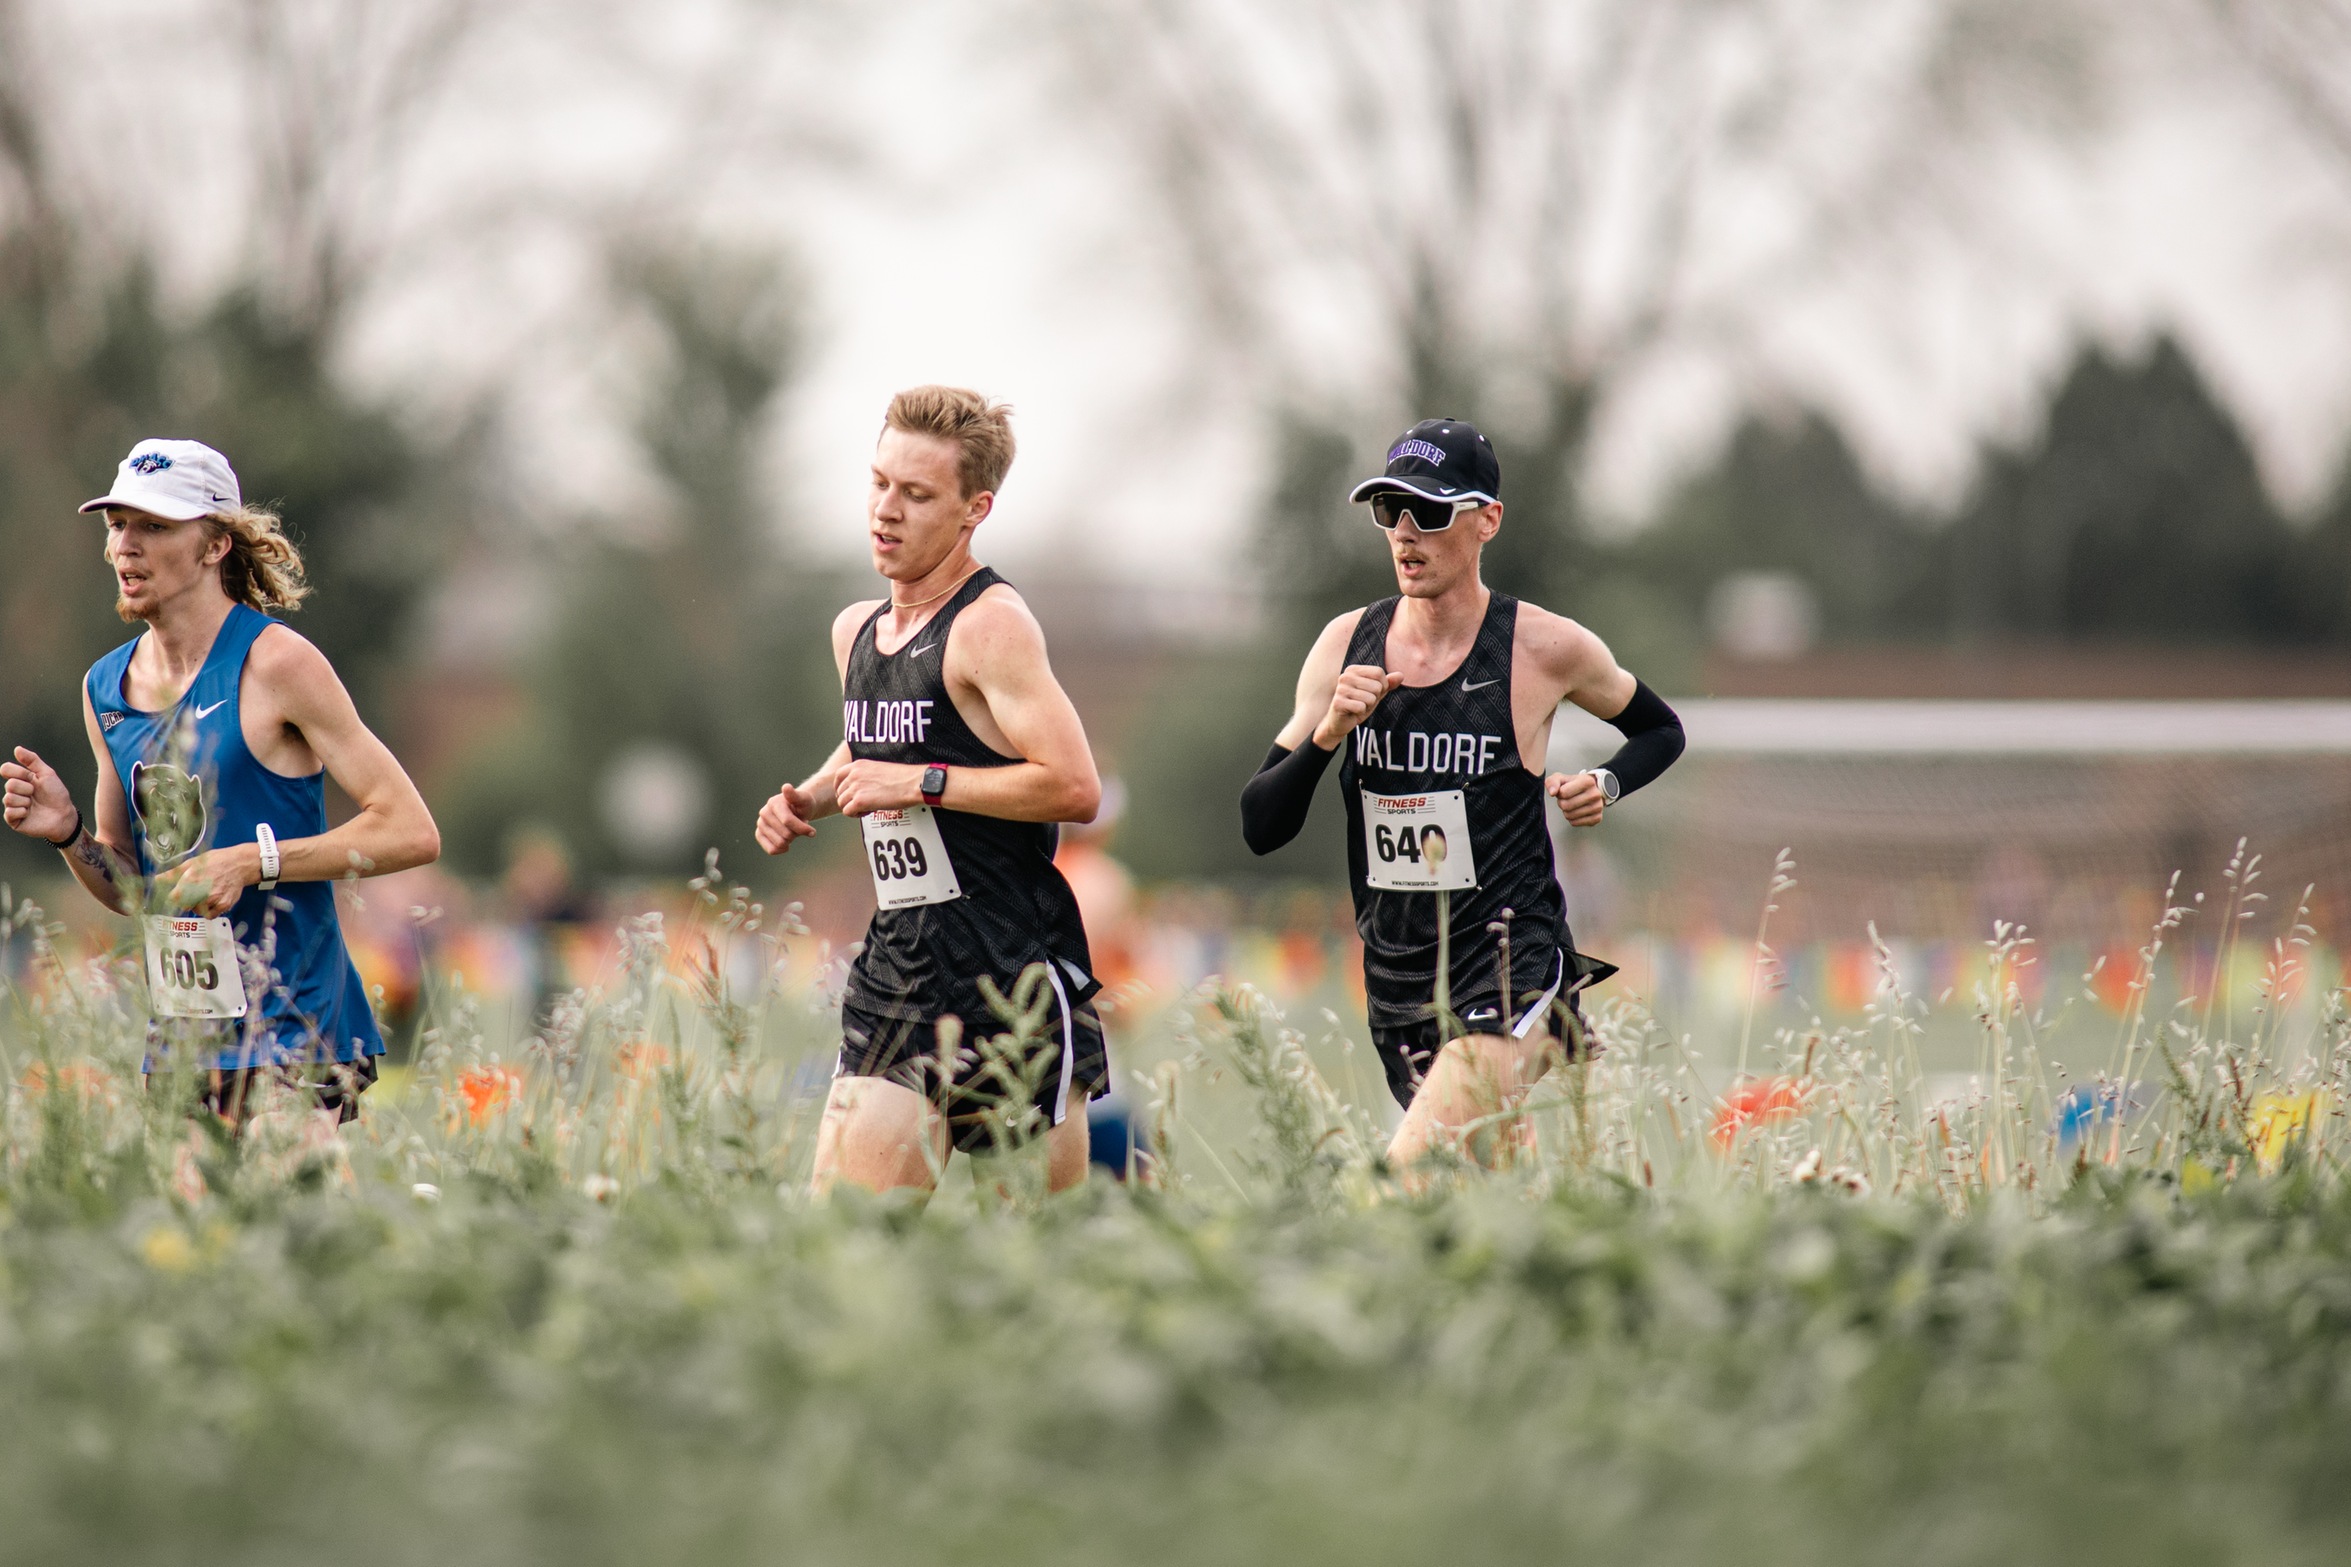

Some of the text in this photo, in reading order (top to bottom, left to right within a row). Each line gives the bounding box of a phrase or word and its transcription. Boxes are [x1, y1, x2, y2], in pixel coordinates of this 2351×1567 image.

[1377, 797, 1427, 808] FITNESS
[873, 808, 904, 821] FITNESS
[880, 820, 900, 828] SPORTS
[873, 836, 928, 881] 639
[160, 946, 219, 991] 605
